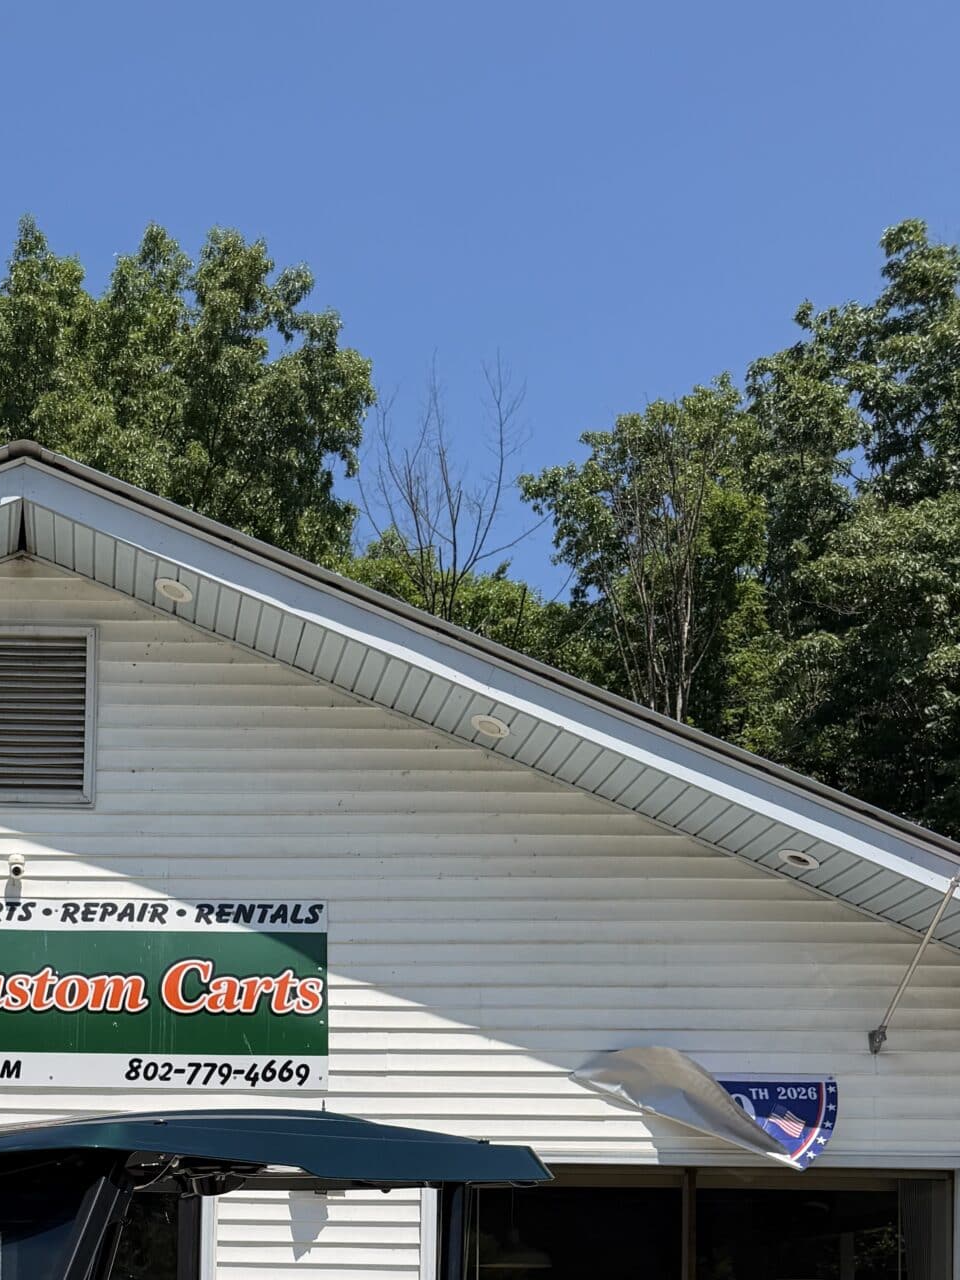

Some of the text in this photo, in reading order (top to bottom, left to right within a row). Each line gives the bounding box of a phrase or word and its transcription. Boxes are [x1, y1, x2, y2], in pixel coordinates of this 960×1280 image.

[61, 903, 169, 924] REPAIR
[196, 904, 323, 925] RENTALS
[161, 959, 323, 1014] Carts
[125, 1058, 310, 1088] 802-779-4669
[777, 1087, 818, 1100] 2026
